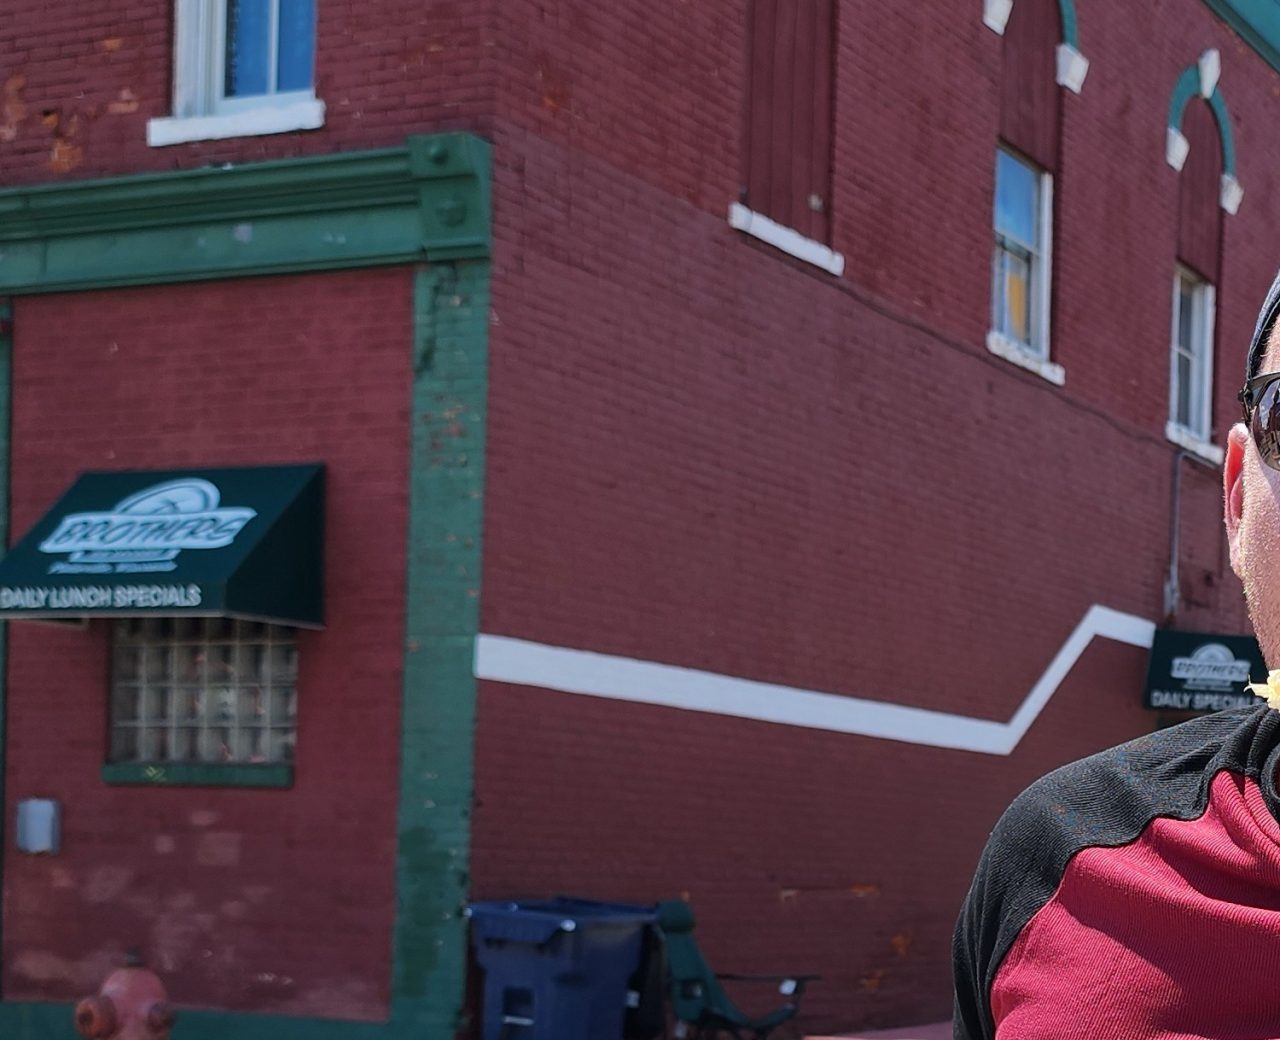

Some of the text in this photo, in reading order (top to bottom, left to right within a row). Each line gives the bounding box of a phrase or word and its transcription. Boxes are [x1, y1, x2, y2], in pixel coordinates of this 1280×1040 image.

[55, 517, 240, 544] BROTHERS
[0, 583, 202, 608] DAILY LUNCH SPECIALS
[1150, 690, 1190, 708] DAILY
